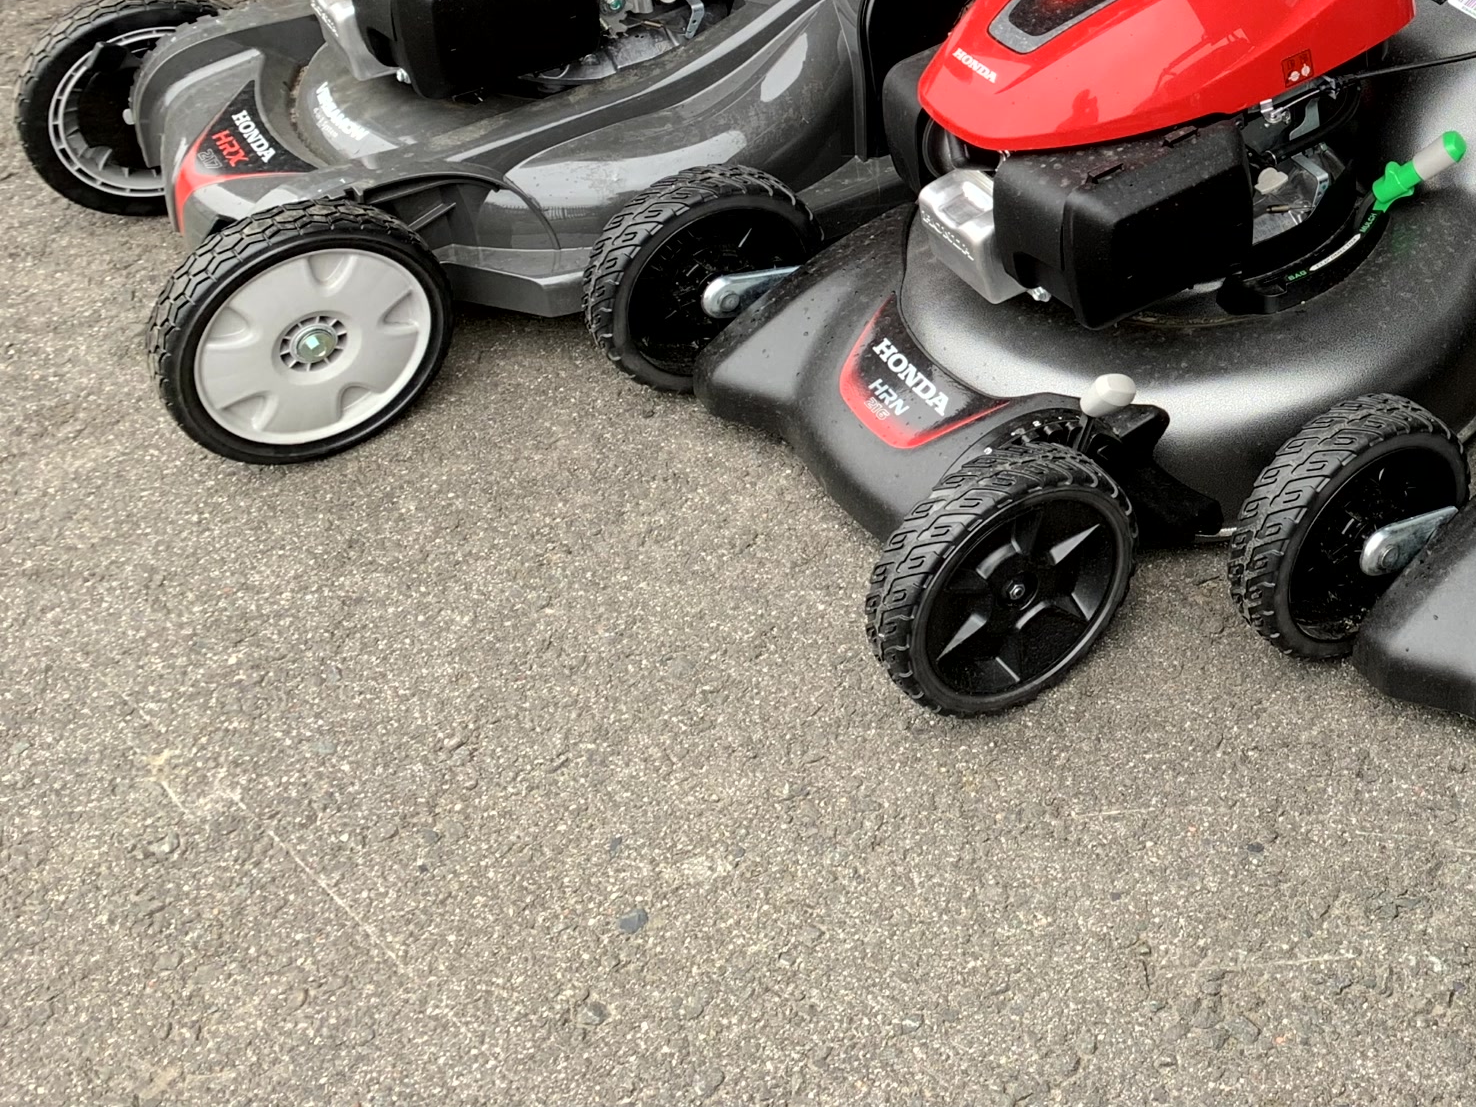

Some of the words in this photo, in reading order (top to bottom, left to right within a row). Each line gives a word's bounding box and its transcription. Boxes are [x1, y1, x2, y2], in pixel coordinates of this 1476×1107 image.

[952, 47, 997, 83] HONDA
[211, 130, 249, 167] HRX
[231, 110, 276, 163] HONDA
[197, 148, 222, 169] 217
[872, 337, 949, 417] HONDA
[863, 396, 890, 421] 216
[868, 378, 910, 416] HRN
